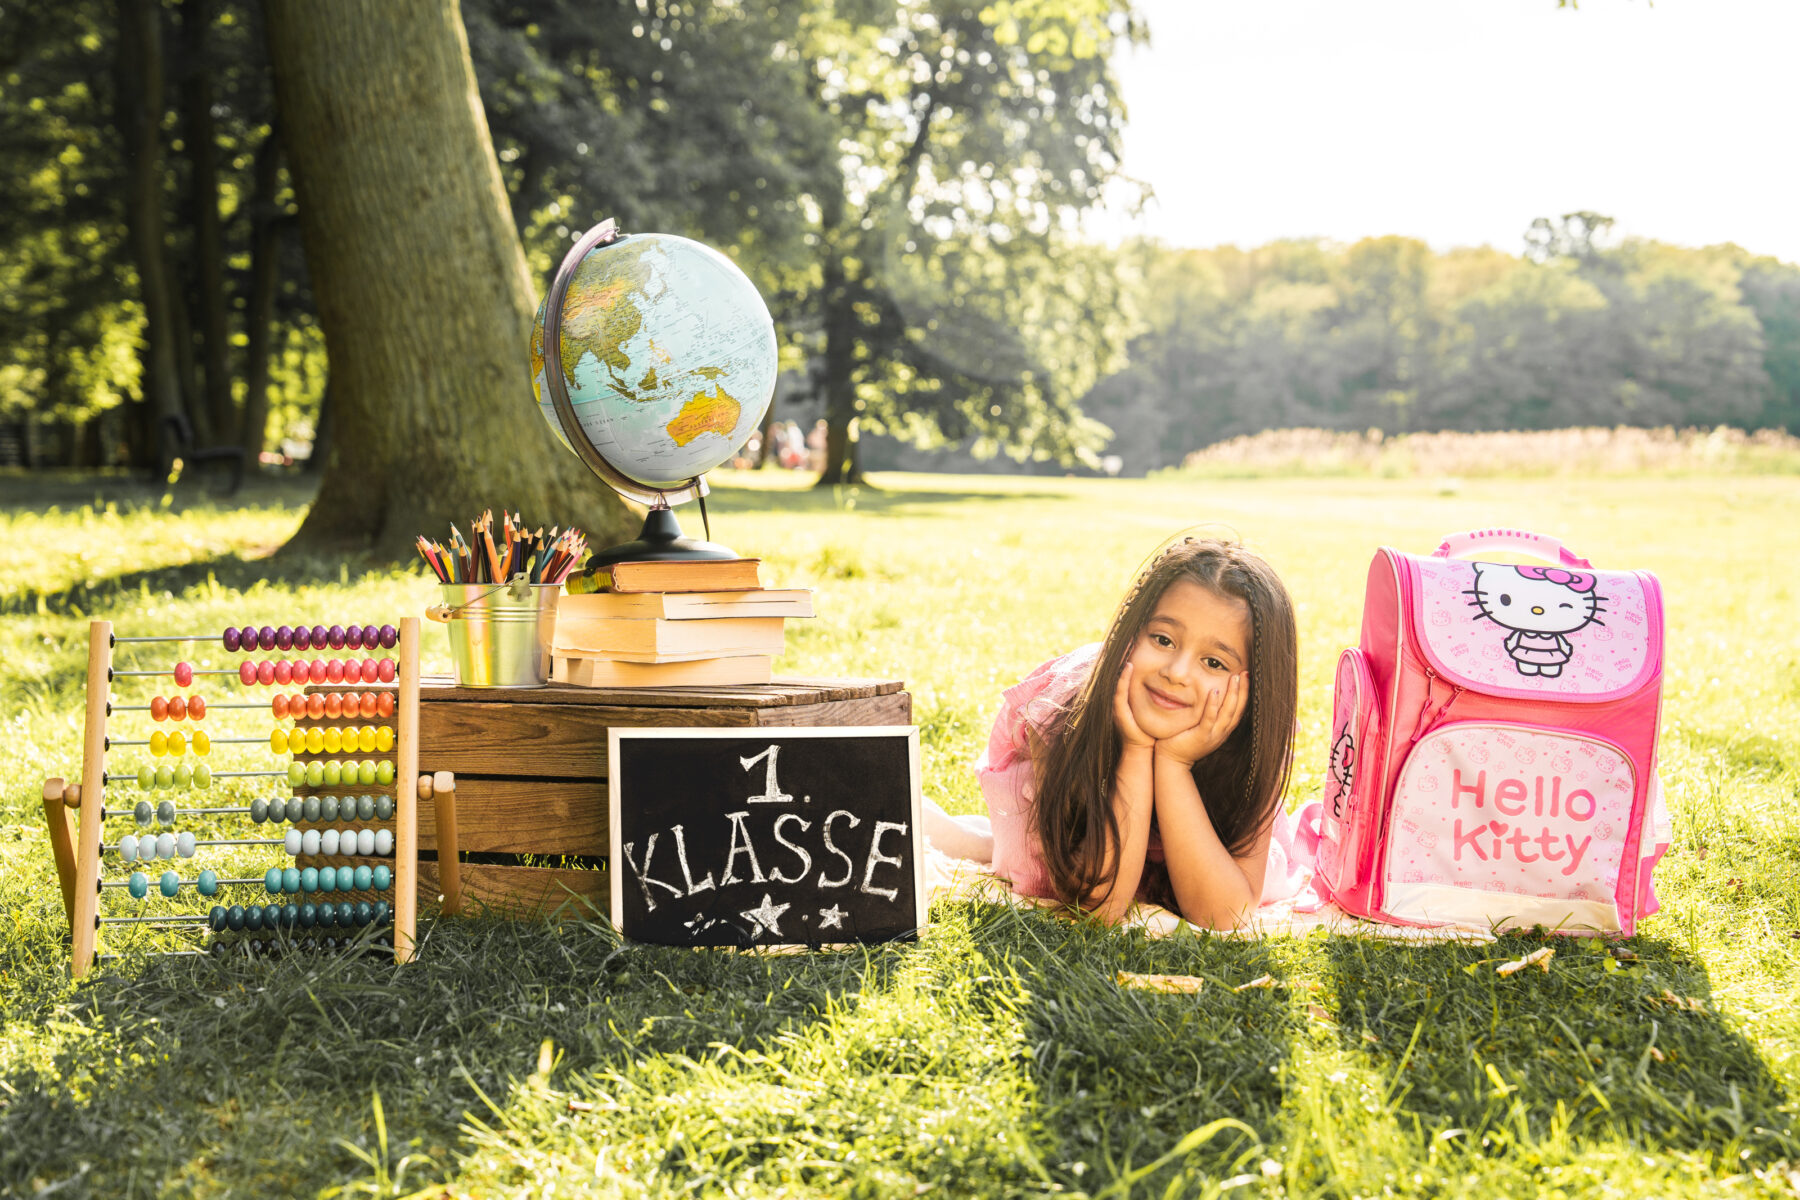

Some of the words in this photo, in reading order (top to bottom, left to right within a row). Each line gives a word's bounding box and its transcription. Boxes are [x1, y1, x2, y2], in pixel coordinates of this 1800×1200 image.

[740, 744, 811, 803] 1.
[1452, 769, 1596, 821] Hello
[623, 810, 908, 912] KLASSE
[1453, 818, 1592, 876] Kitty
